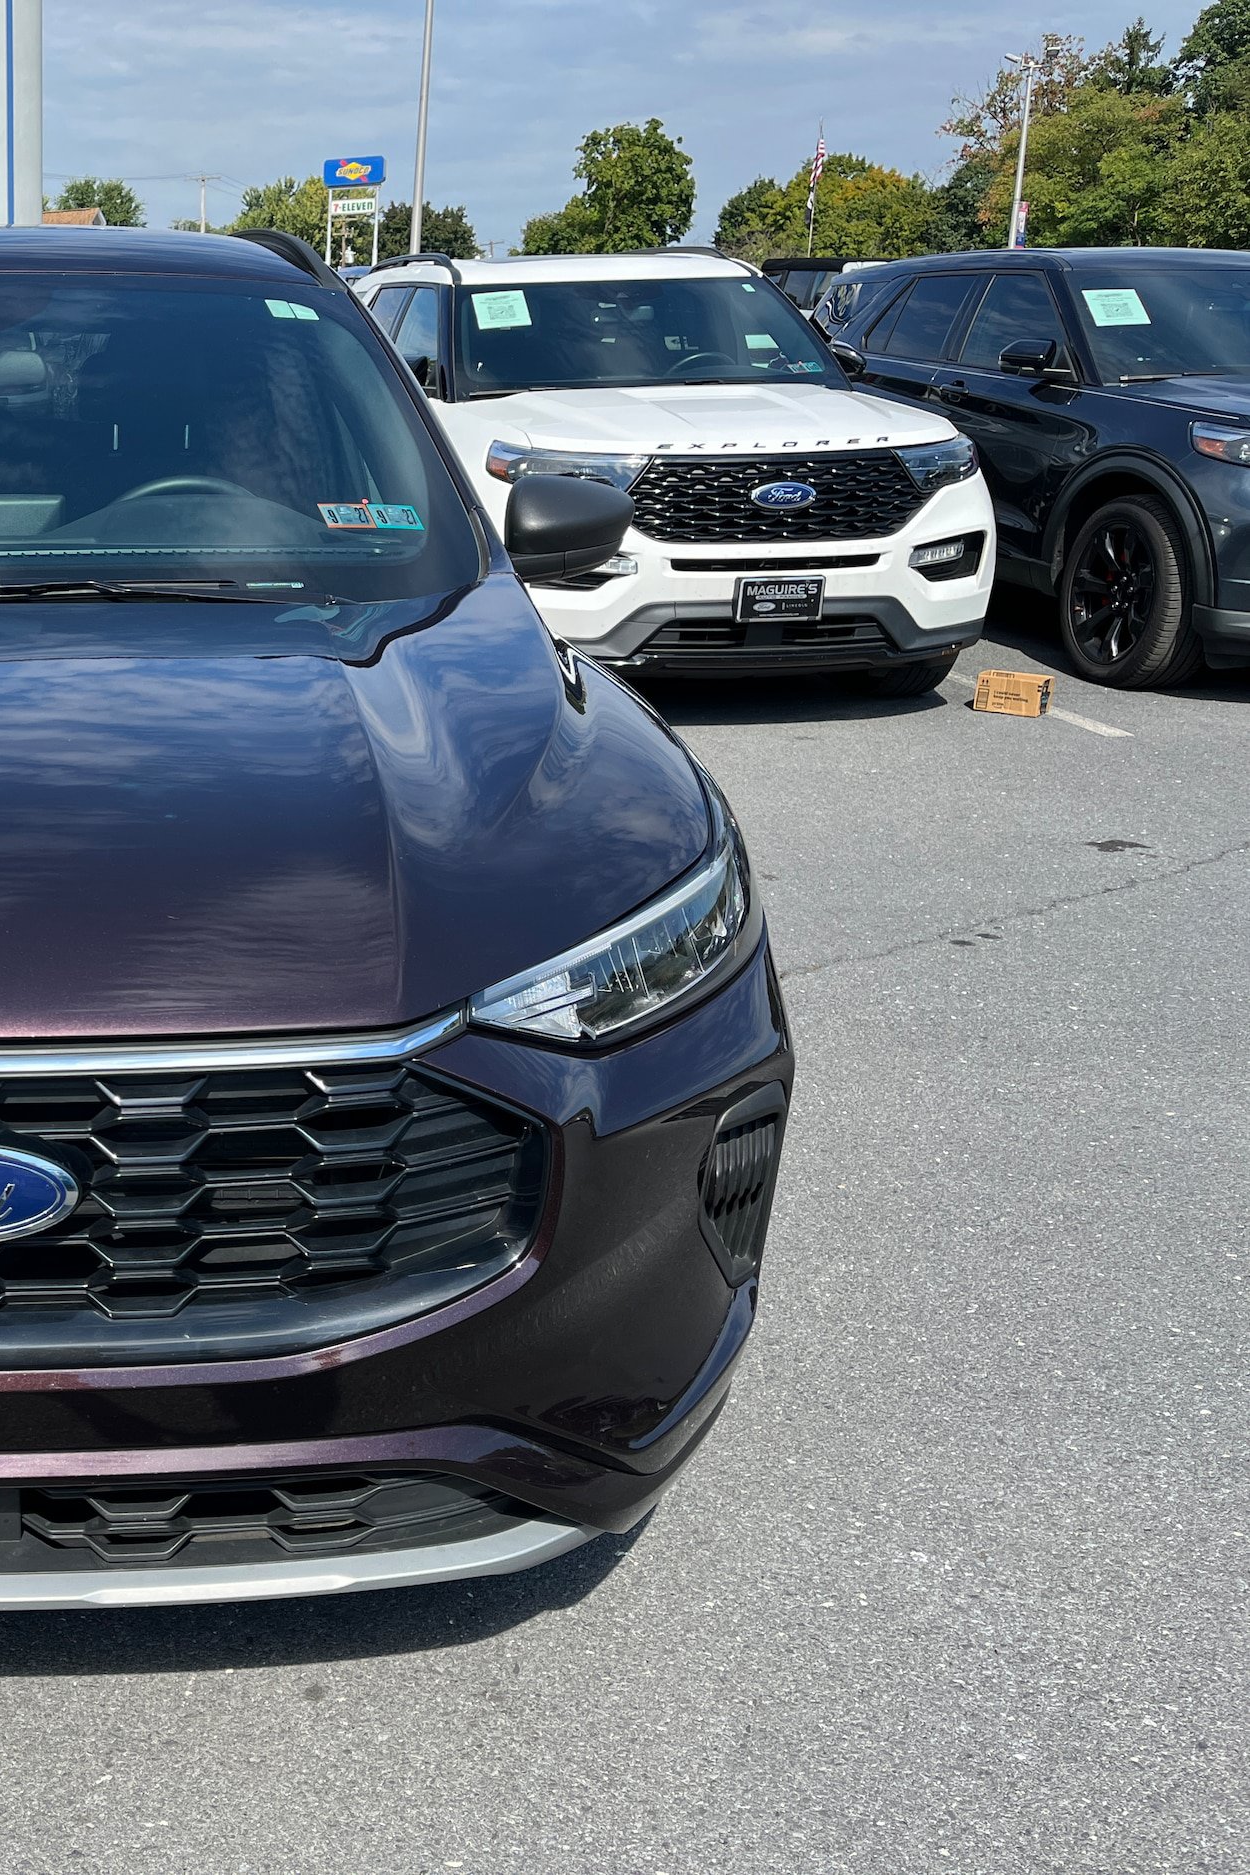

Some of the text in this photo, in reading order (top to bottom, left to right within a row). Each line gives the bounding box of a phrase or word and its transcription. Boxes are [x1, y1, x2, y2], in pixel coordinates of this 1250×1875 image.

[338, 166, 370, 176] SUNOCO
[656, 436, 889, 450] EXPLORER
[768, 487, 803, 503] Ford
[746, 583, 818, 596] MAGUIRE'S
